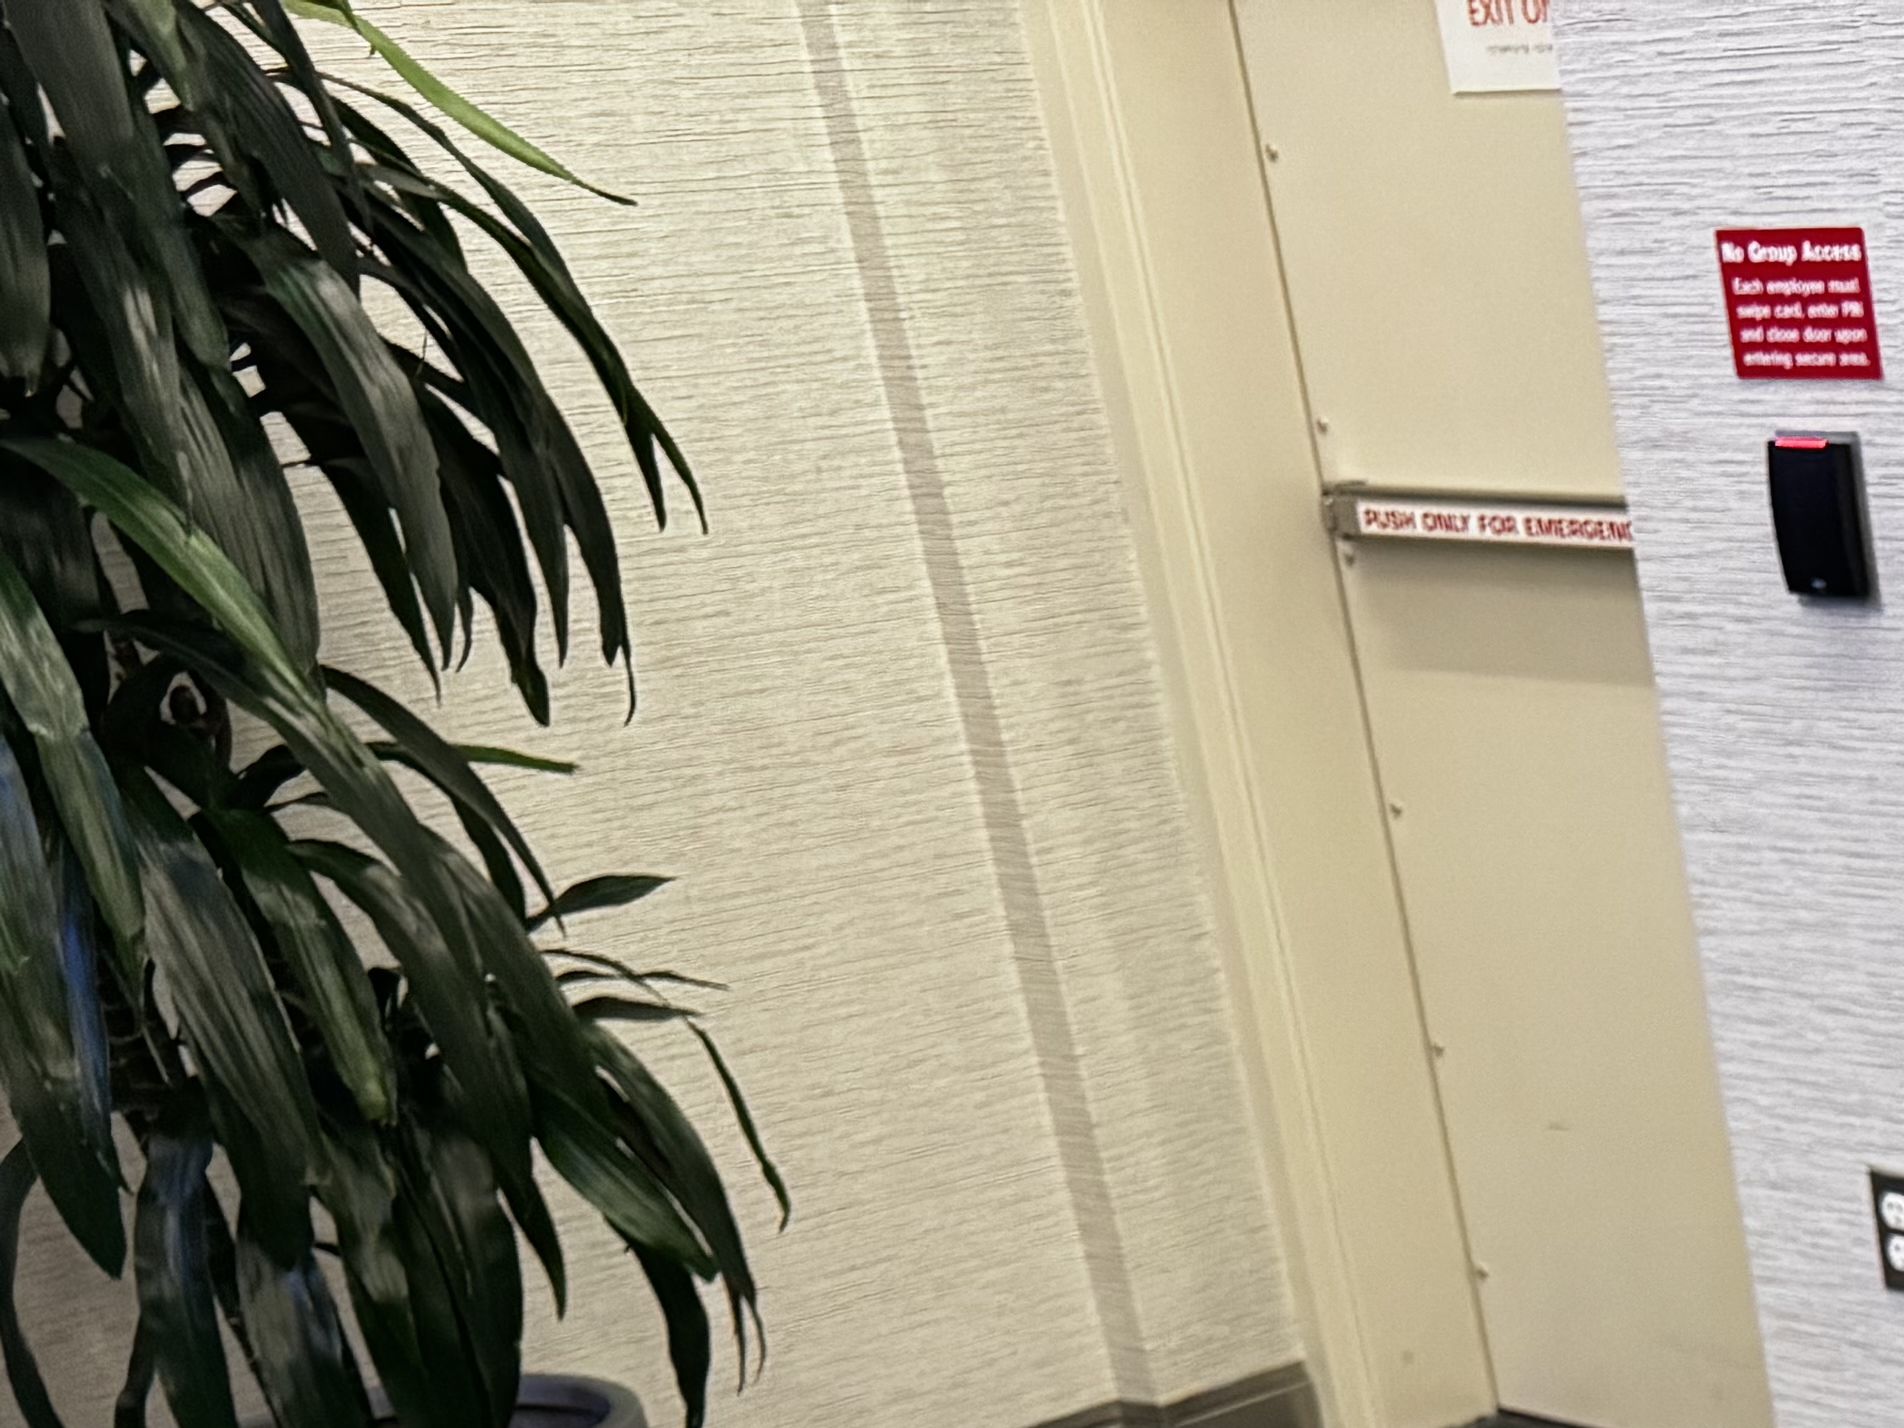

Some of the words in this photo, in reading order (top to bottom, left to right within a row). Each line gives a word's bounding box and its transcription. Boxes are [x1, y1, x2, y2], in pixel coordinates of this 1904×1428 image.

[1721, 242, 1744, 263] No
[1748, 240, 1797, 266] Group
[1801, 240, 1861, 262] Access
[1766, 278, 1825, 297] employee
[1363, 508, 1416, 530] PUSH
[1421, 511, 1470, 533] ONLY
[1477, 515, 1517, 536] FOR
